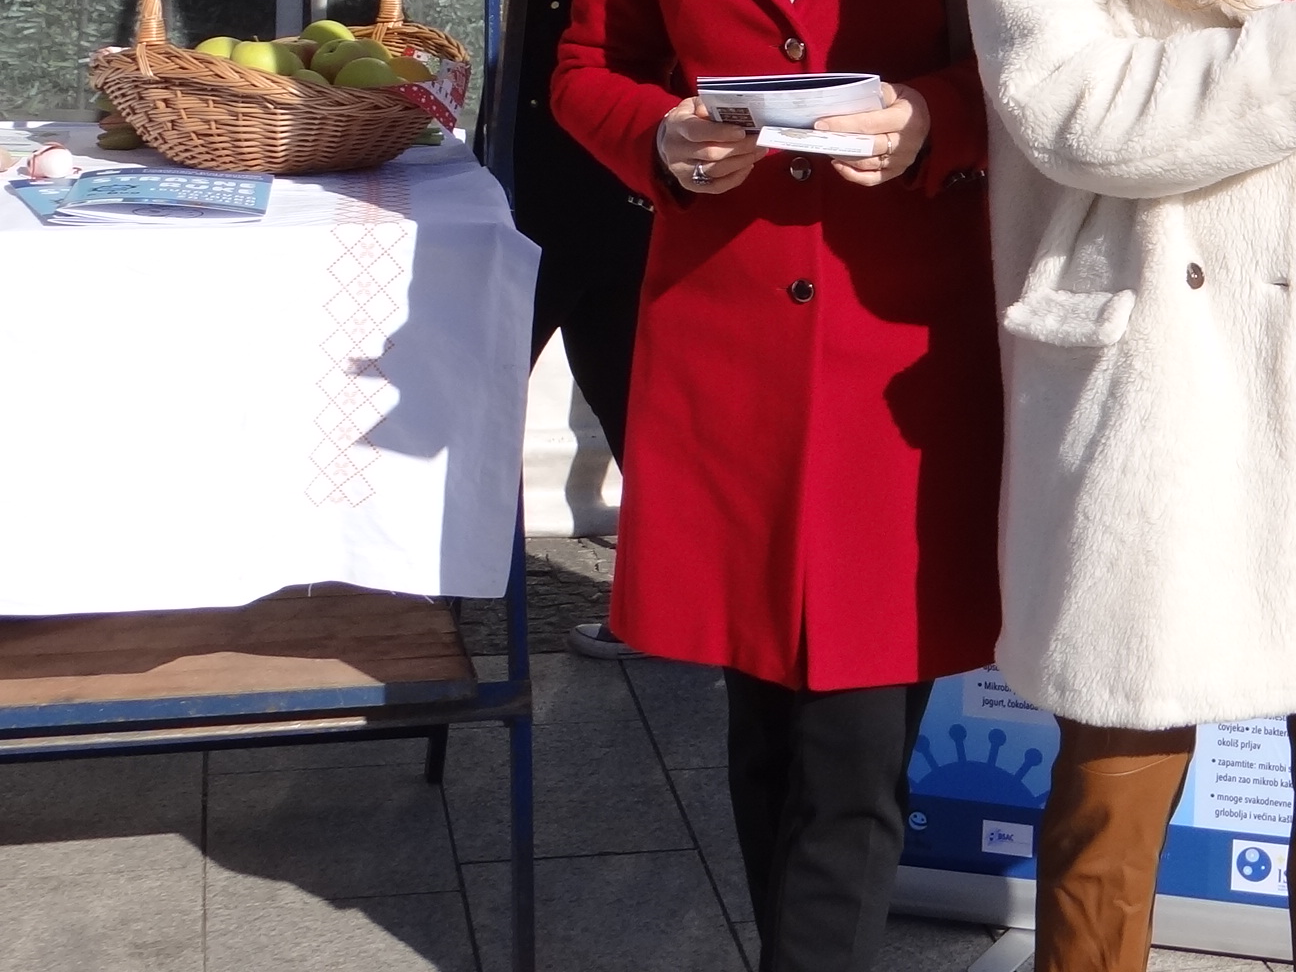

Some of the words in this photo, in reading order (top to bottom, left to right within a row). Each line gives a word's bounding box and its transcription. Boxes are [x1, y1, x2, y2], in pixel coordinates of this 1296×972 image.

[982, 696, 1006, 708] jogurt,
[1251, 725, 1262, 735] zle
[1217, 738, 1239, 748] okoliš
[1240, 741, 1261, 752] prljav
[1218, 758, 1257, 770] zapamtite:
[1258, 762, 1287, 773] mikrobi
[1215, 773, 1237, 784] jedan
[1238, 776, 1251, 785] zao
[1252, 777, 1279, 788] mikrob
[1216, 794, 1243, 805] mnoge
[1244, 796, 1292, 808] svakodnevne
[1214, 808, 1248, 821] grlobolja
[1253, 812, 1277, 823] većina
